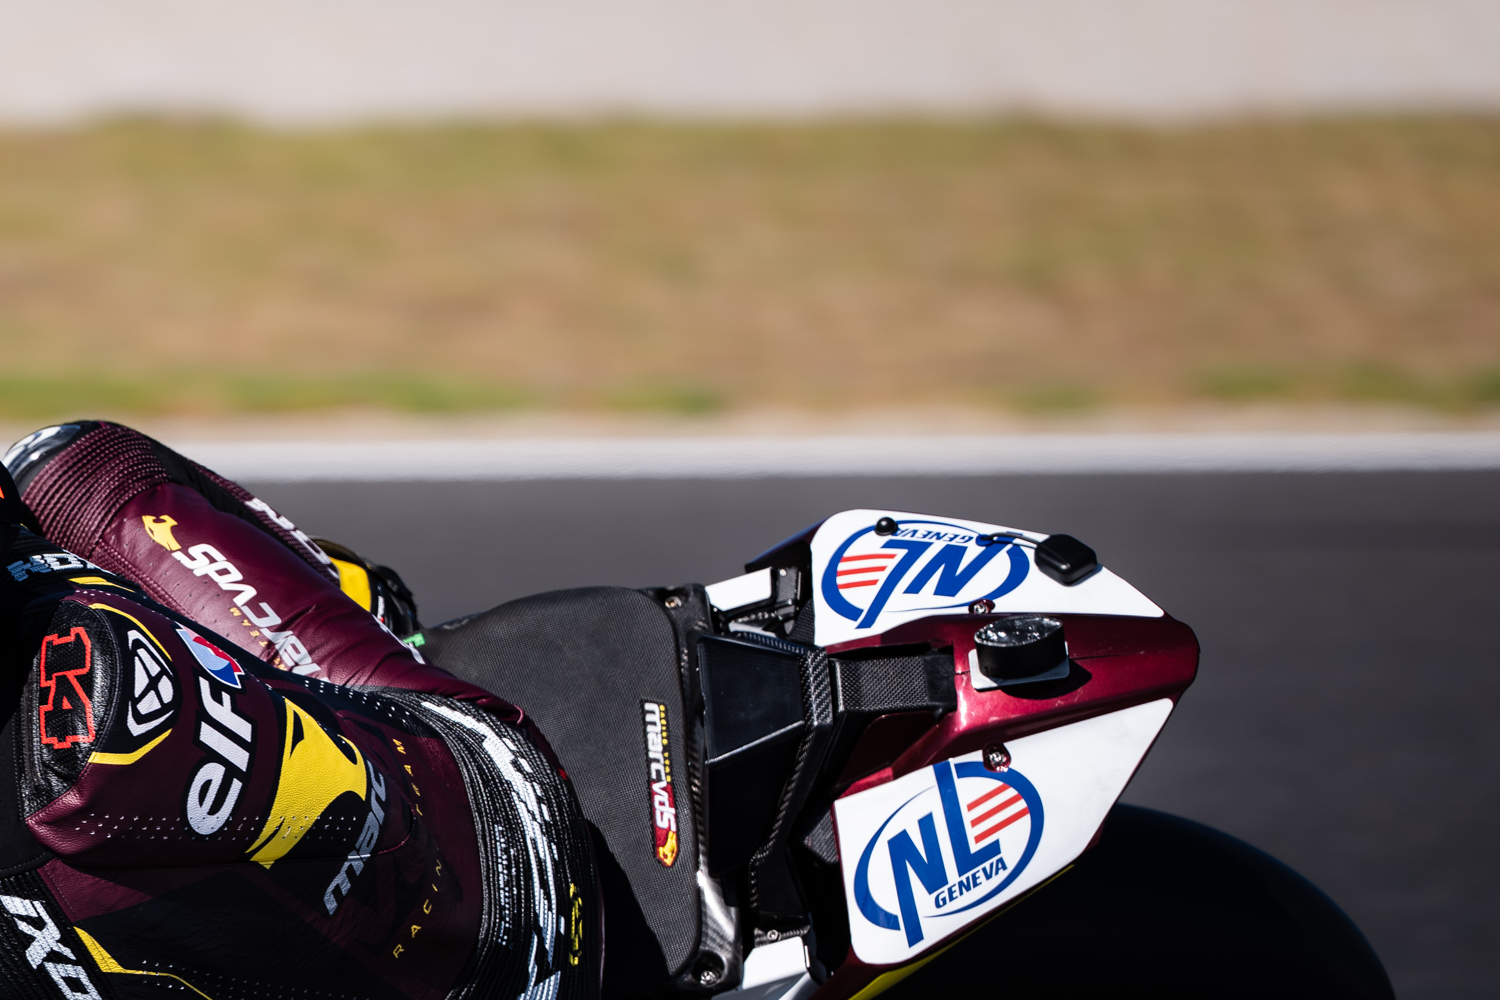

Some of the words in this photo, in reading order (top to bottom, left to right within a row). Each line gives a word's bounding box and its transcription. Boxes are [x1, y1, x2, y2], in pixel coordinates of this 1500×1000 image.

[896, 528, 974, 545] GENEVA
[38, 626, 96, 749] 14
[186, 676, 253, 836] elf
[887, 758, 1002, 949] NL
[934, 857, 1008, 910] GENEVA
